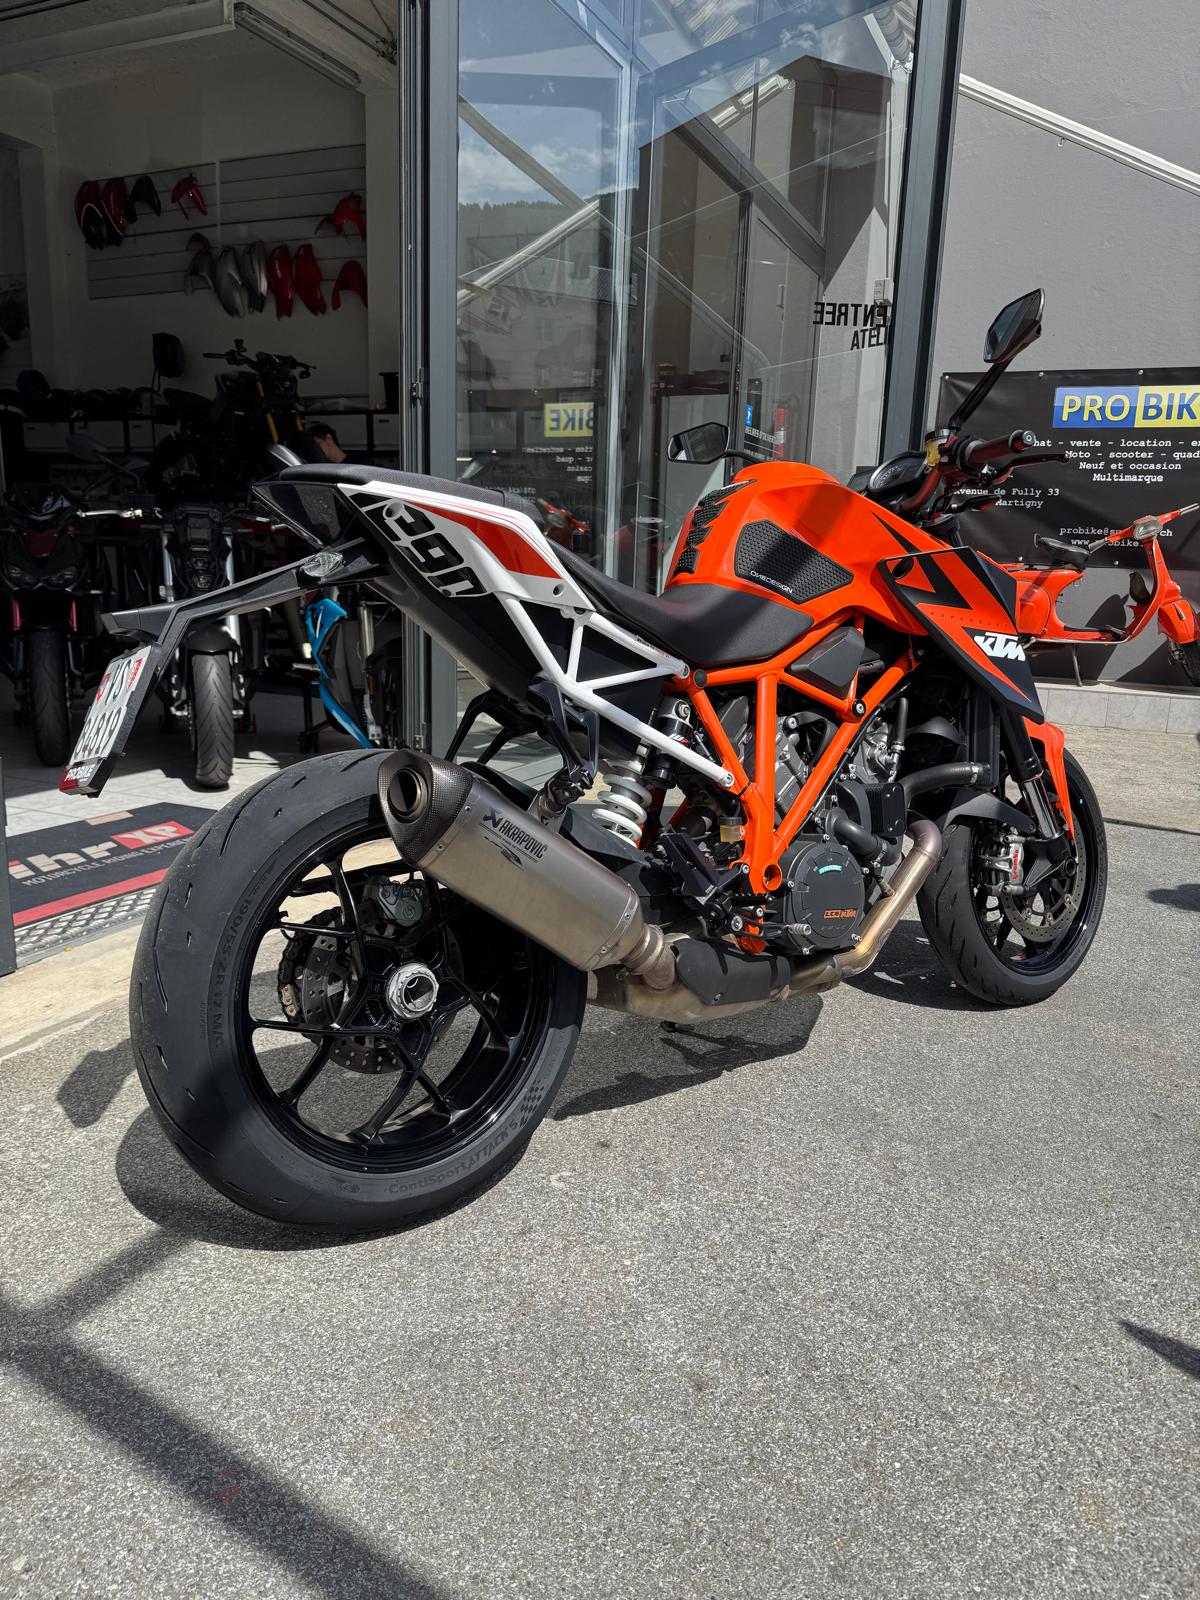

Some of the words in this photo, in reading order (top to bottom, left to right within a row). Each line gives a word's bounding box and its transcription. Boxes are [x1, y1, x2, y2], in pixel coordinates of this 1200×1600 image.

[1062, 394, 1131, 422] PRO
[1142, 392, 1200, 421] BIK
[1033, 438, 1052, 447] hat
[1070, 439, 1101, 447] vente
[1120, 438, 1172, 447] location
[1064, 450, 1091, 458] Moto
[1173, 450, 1200, 460] quad
[1079, 462, 1105, 470] Neuf
[1129, 462, 1182, 470] occasion
[1092, 473, 1164, 484] Multimarque
[1012, 488, 1042, 498] Fully
[1048, 488, 1060, 496] 33
[995, 499, 1044, 508] Martigny
[973, 632, 1026, 662] KTM
[105, 658, 133, 706] VS
[64, 764, 95, 782] PROBIKE
[22, 858, 105, 887] MOTORCYCLE
